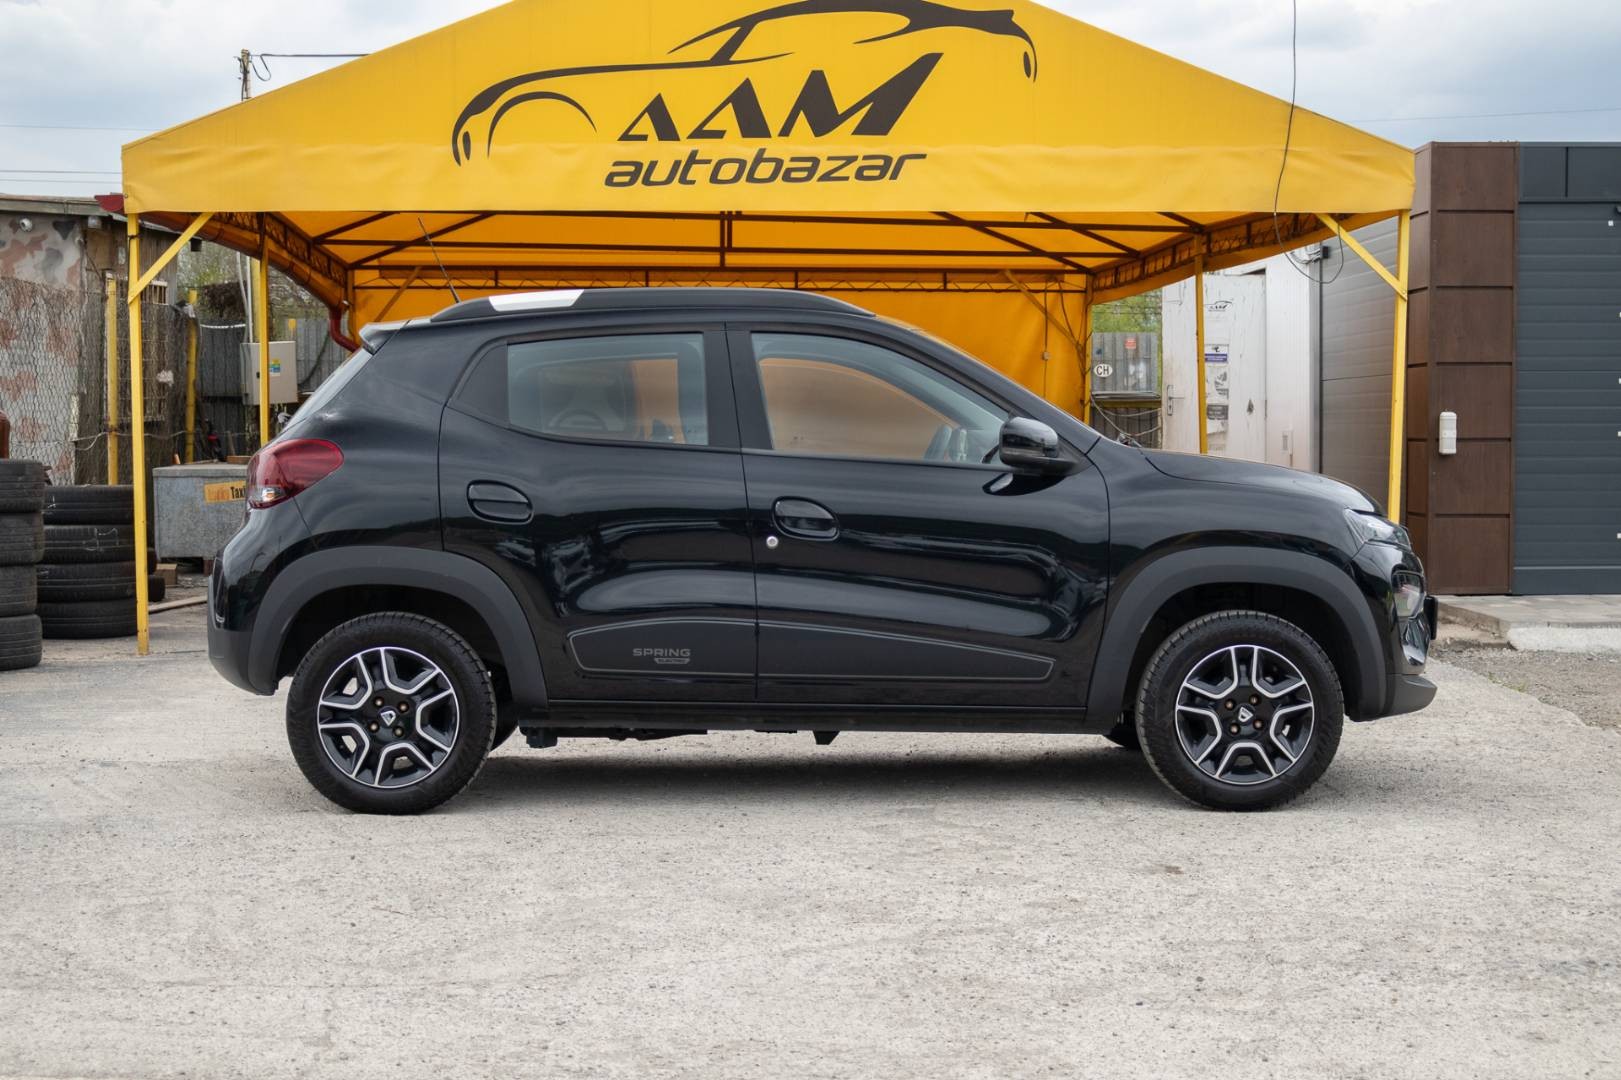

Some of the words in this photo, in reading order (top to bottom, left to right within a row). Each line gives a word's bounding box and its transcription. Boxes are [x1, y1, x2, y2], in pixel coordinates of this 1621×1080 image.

[617, 52, 944, 142] AAM
[604, 147, 928, 187] autobazar
[1096, 365, 1110, 376] CH
[632, 648, 691, 657] SPRING
